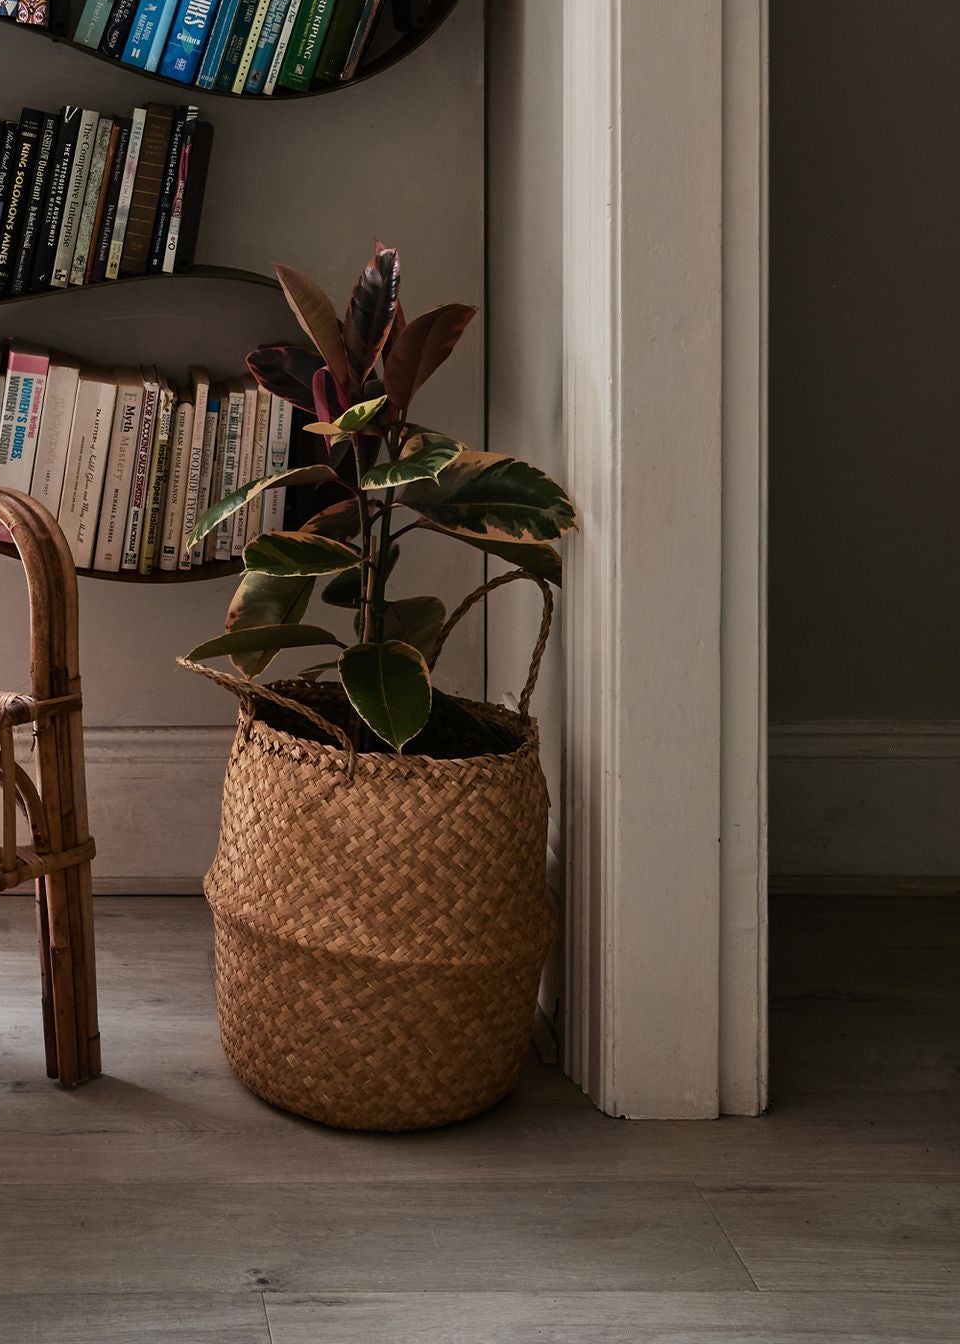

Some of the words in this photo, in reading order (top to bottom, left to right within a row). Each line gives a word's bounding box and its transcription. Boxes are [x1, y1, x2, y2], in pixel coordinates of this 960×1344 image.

[90, 1, 103, 21] Itself
[131, 13, 147, 43] MARTINEZ
[141, 21, 153, 40] RAOUL
[302, 15, 322, 60] KIPLING
[81, 121, 93, 139] The
[174, 120, 183, 132] The
[17, 142, 31, 168] KING
[63, 142, 71, 155] THE
[170, 133, 181, 154] Secret
[56, 158, 69, 194] TATTOOIST
[70, 141, 90, 199] Competitive
[168, 155, 177, 168] Life
[4, 170, 25, 230] SOLOMON'S
[54, 195, 62, 204] OF
[163, 176, 173, 195] Cows
[47, 207, 60, 246] AUSCHWITZ
[61, 201, 78, 247] Enterprise
[3, 375, 20, 421] WOMEN'S
[16, 377, 33, 423] WOMEN'S
[144, 390, 155, 416] MAJOR
[120, 404, 135, 433] Myth
[178, 410, 186, 427] THIS
[9, 425, 25, 462] BODIES,
[139, 417, 151, 452] ACCOUNT
[176, 429, 184, 445] MAN
[112, 435, 129, 481] Mastery
[137, 453, 147, 474] SALES
[156, 444, 166, 473] Instant
[174, 447, 182, 468] FROM
[187, 447, 201, 494] POOLSIDE
[132, 475, 144, 508] STRATEGY
[151, 475, 162, 505] Repeat
[170, 469, 180, 504] LEBANON
[146, 507, 158, 544] Business
[184, 496, 197, 535] TYCOON
[128, 523, 137, 551] RACKHAM
